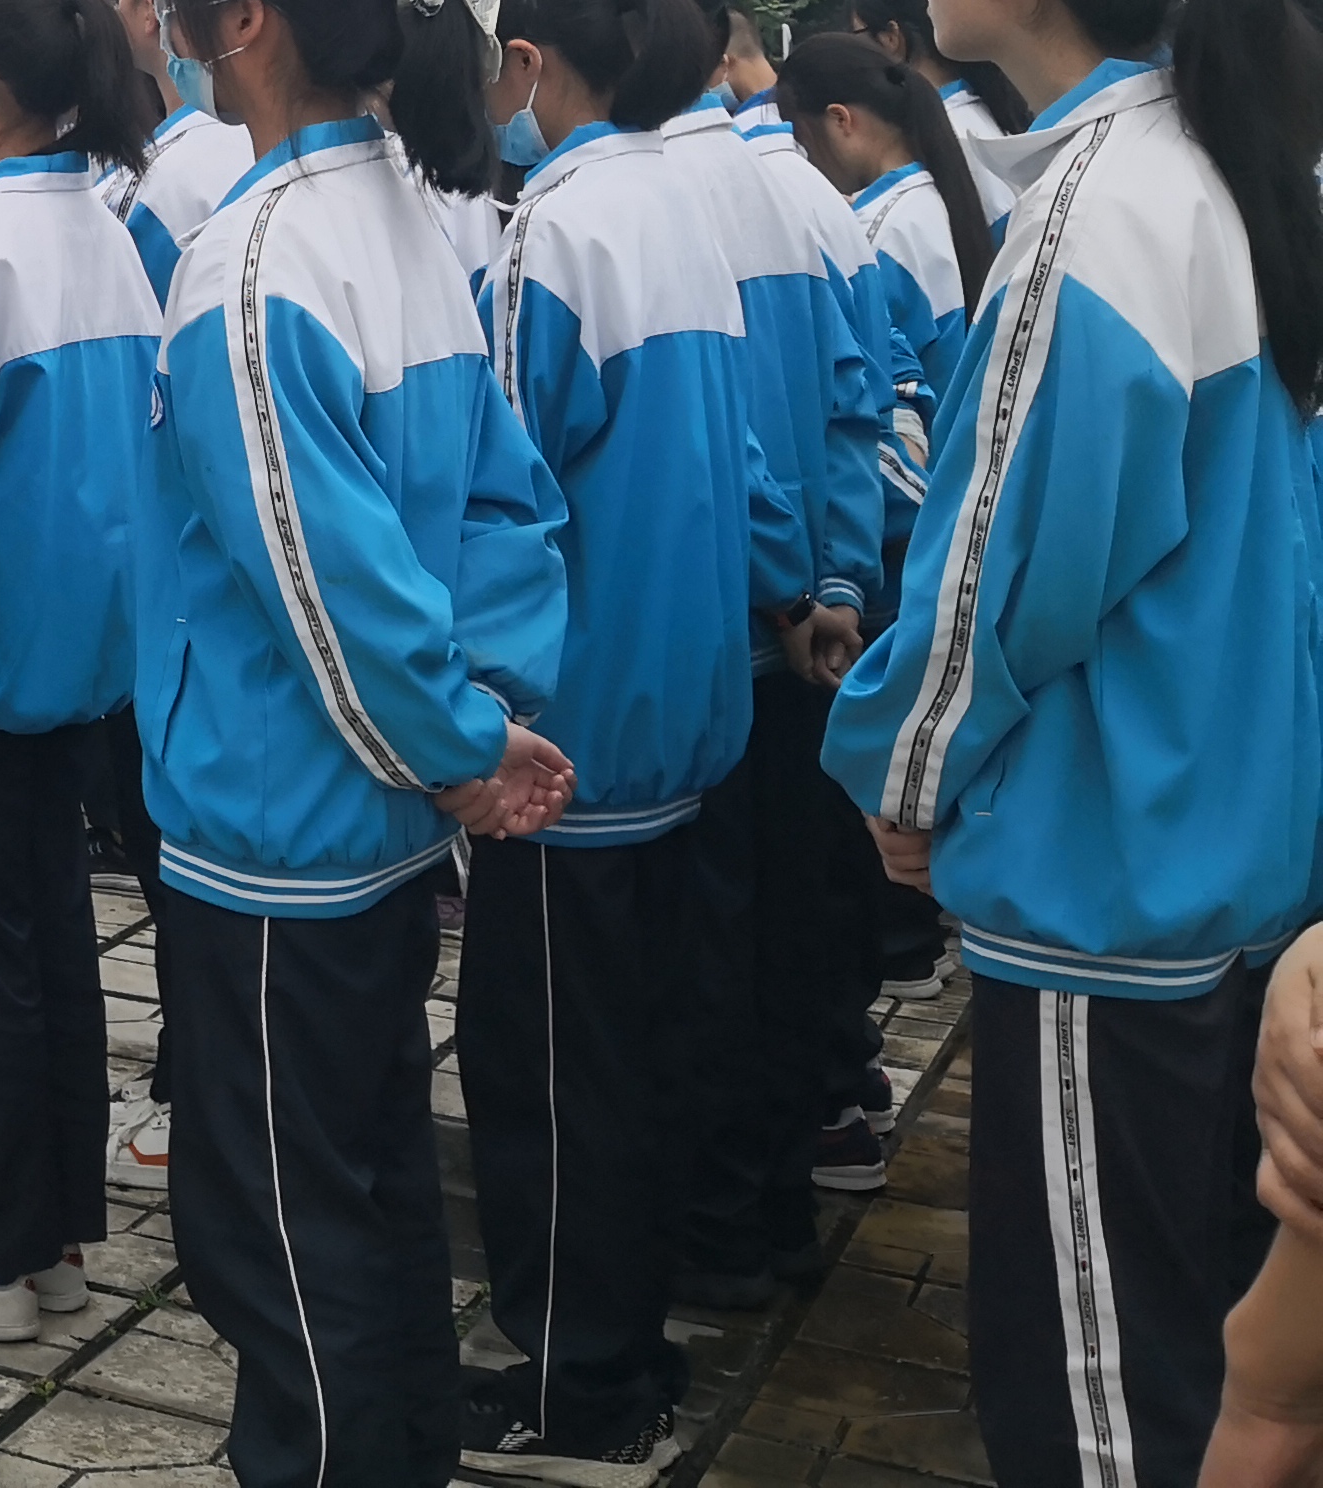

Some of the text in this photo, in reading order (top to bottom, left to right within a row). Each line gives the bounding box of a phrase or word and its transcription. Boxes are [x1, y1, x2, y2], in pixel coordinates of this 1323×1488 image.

[1056, 180, 1074, 215] SPORT
[1030, 263, 1048, 301] SPORT
[1006, 349, 1023, 390] SPORT
[245, 282, 253, 315] SPORT
[280, 518, 295, 552] SPORT
[968, 524, 984, 565] SPORT
[956, 612, 969, 649] SPORT
[929, 689, 951, 723] SPORT
[1060, 1021, 1070, 1061] SPORT
[1066, 1109, 1077, 1148] SPORT
[1074, 1200, 1086, 1241] SPORT
